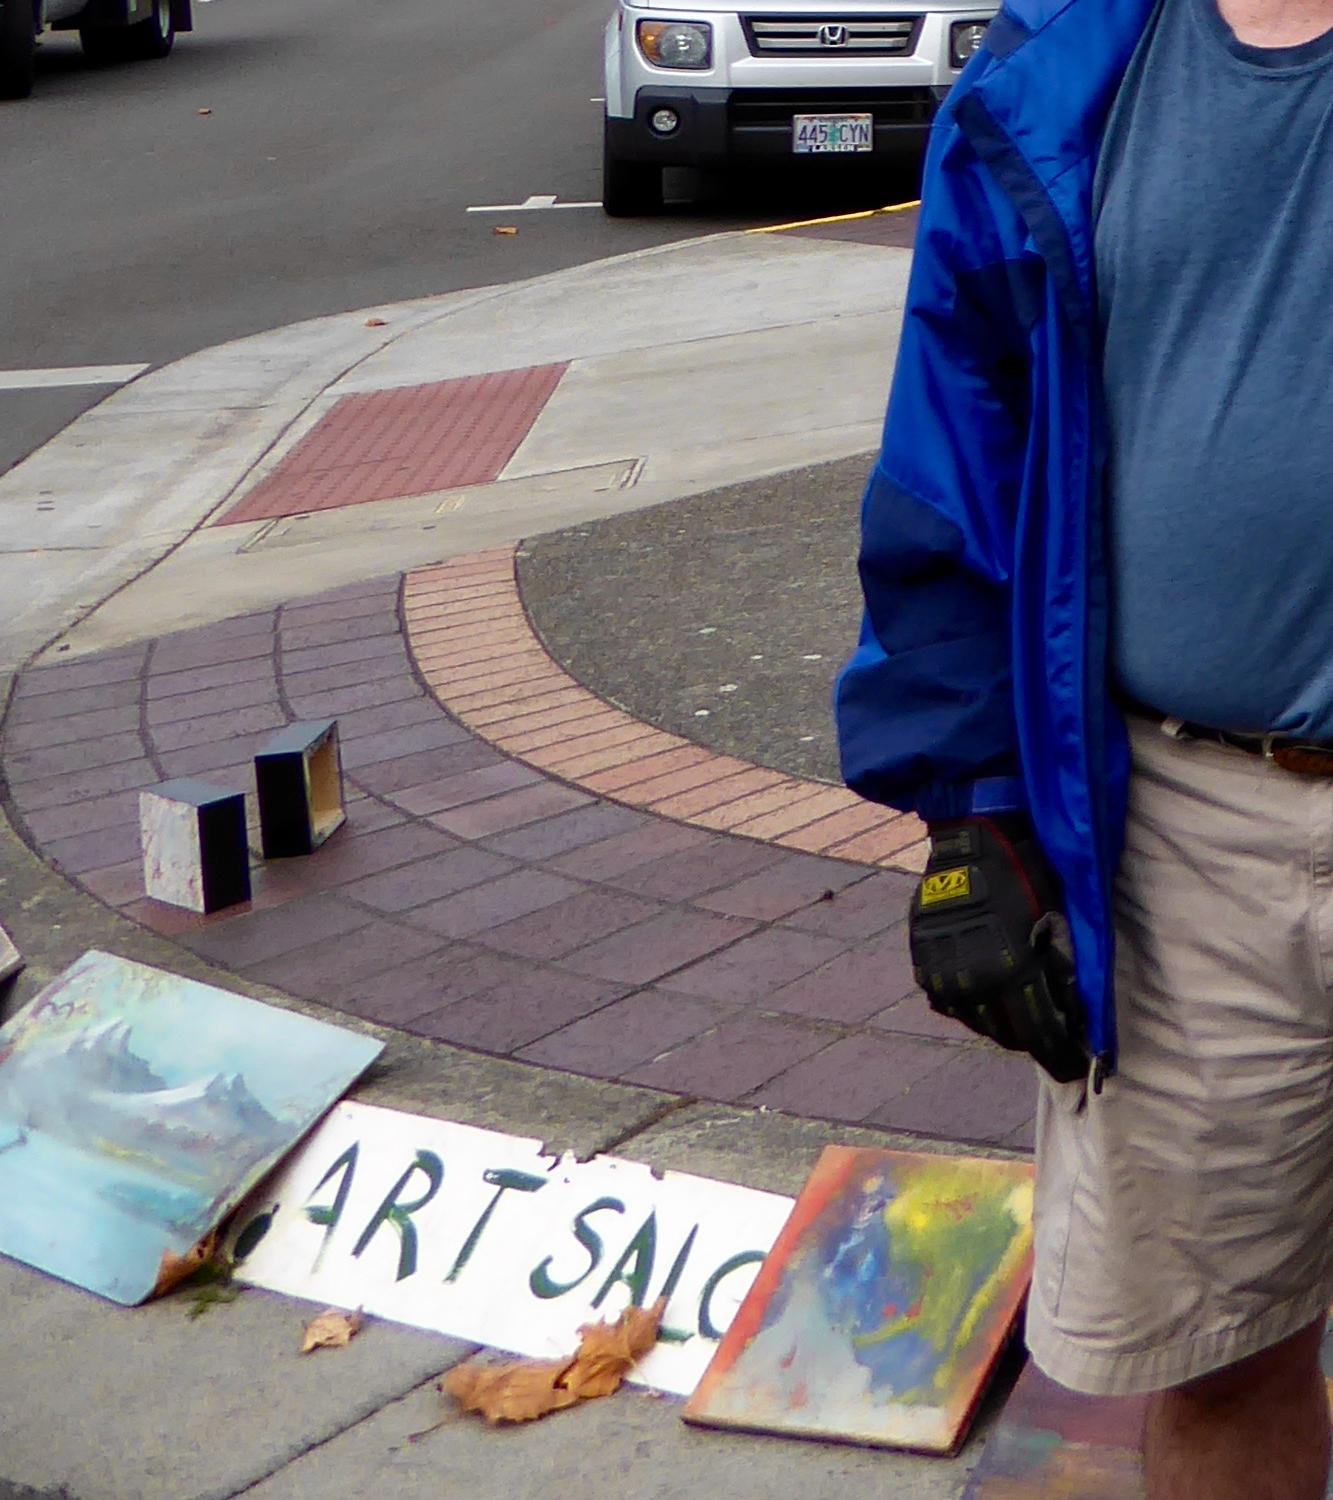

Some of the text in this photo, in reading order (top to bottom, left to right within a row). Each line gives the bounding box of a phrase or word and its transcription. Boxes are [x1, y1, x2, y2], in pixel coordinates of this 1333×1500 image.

[798, 124, 869, 144] 445 CYN
[303, 1141, 548, 1283] ART
